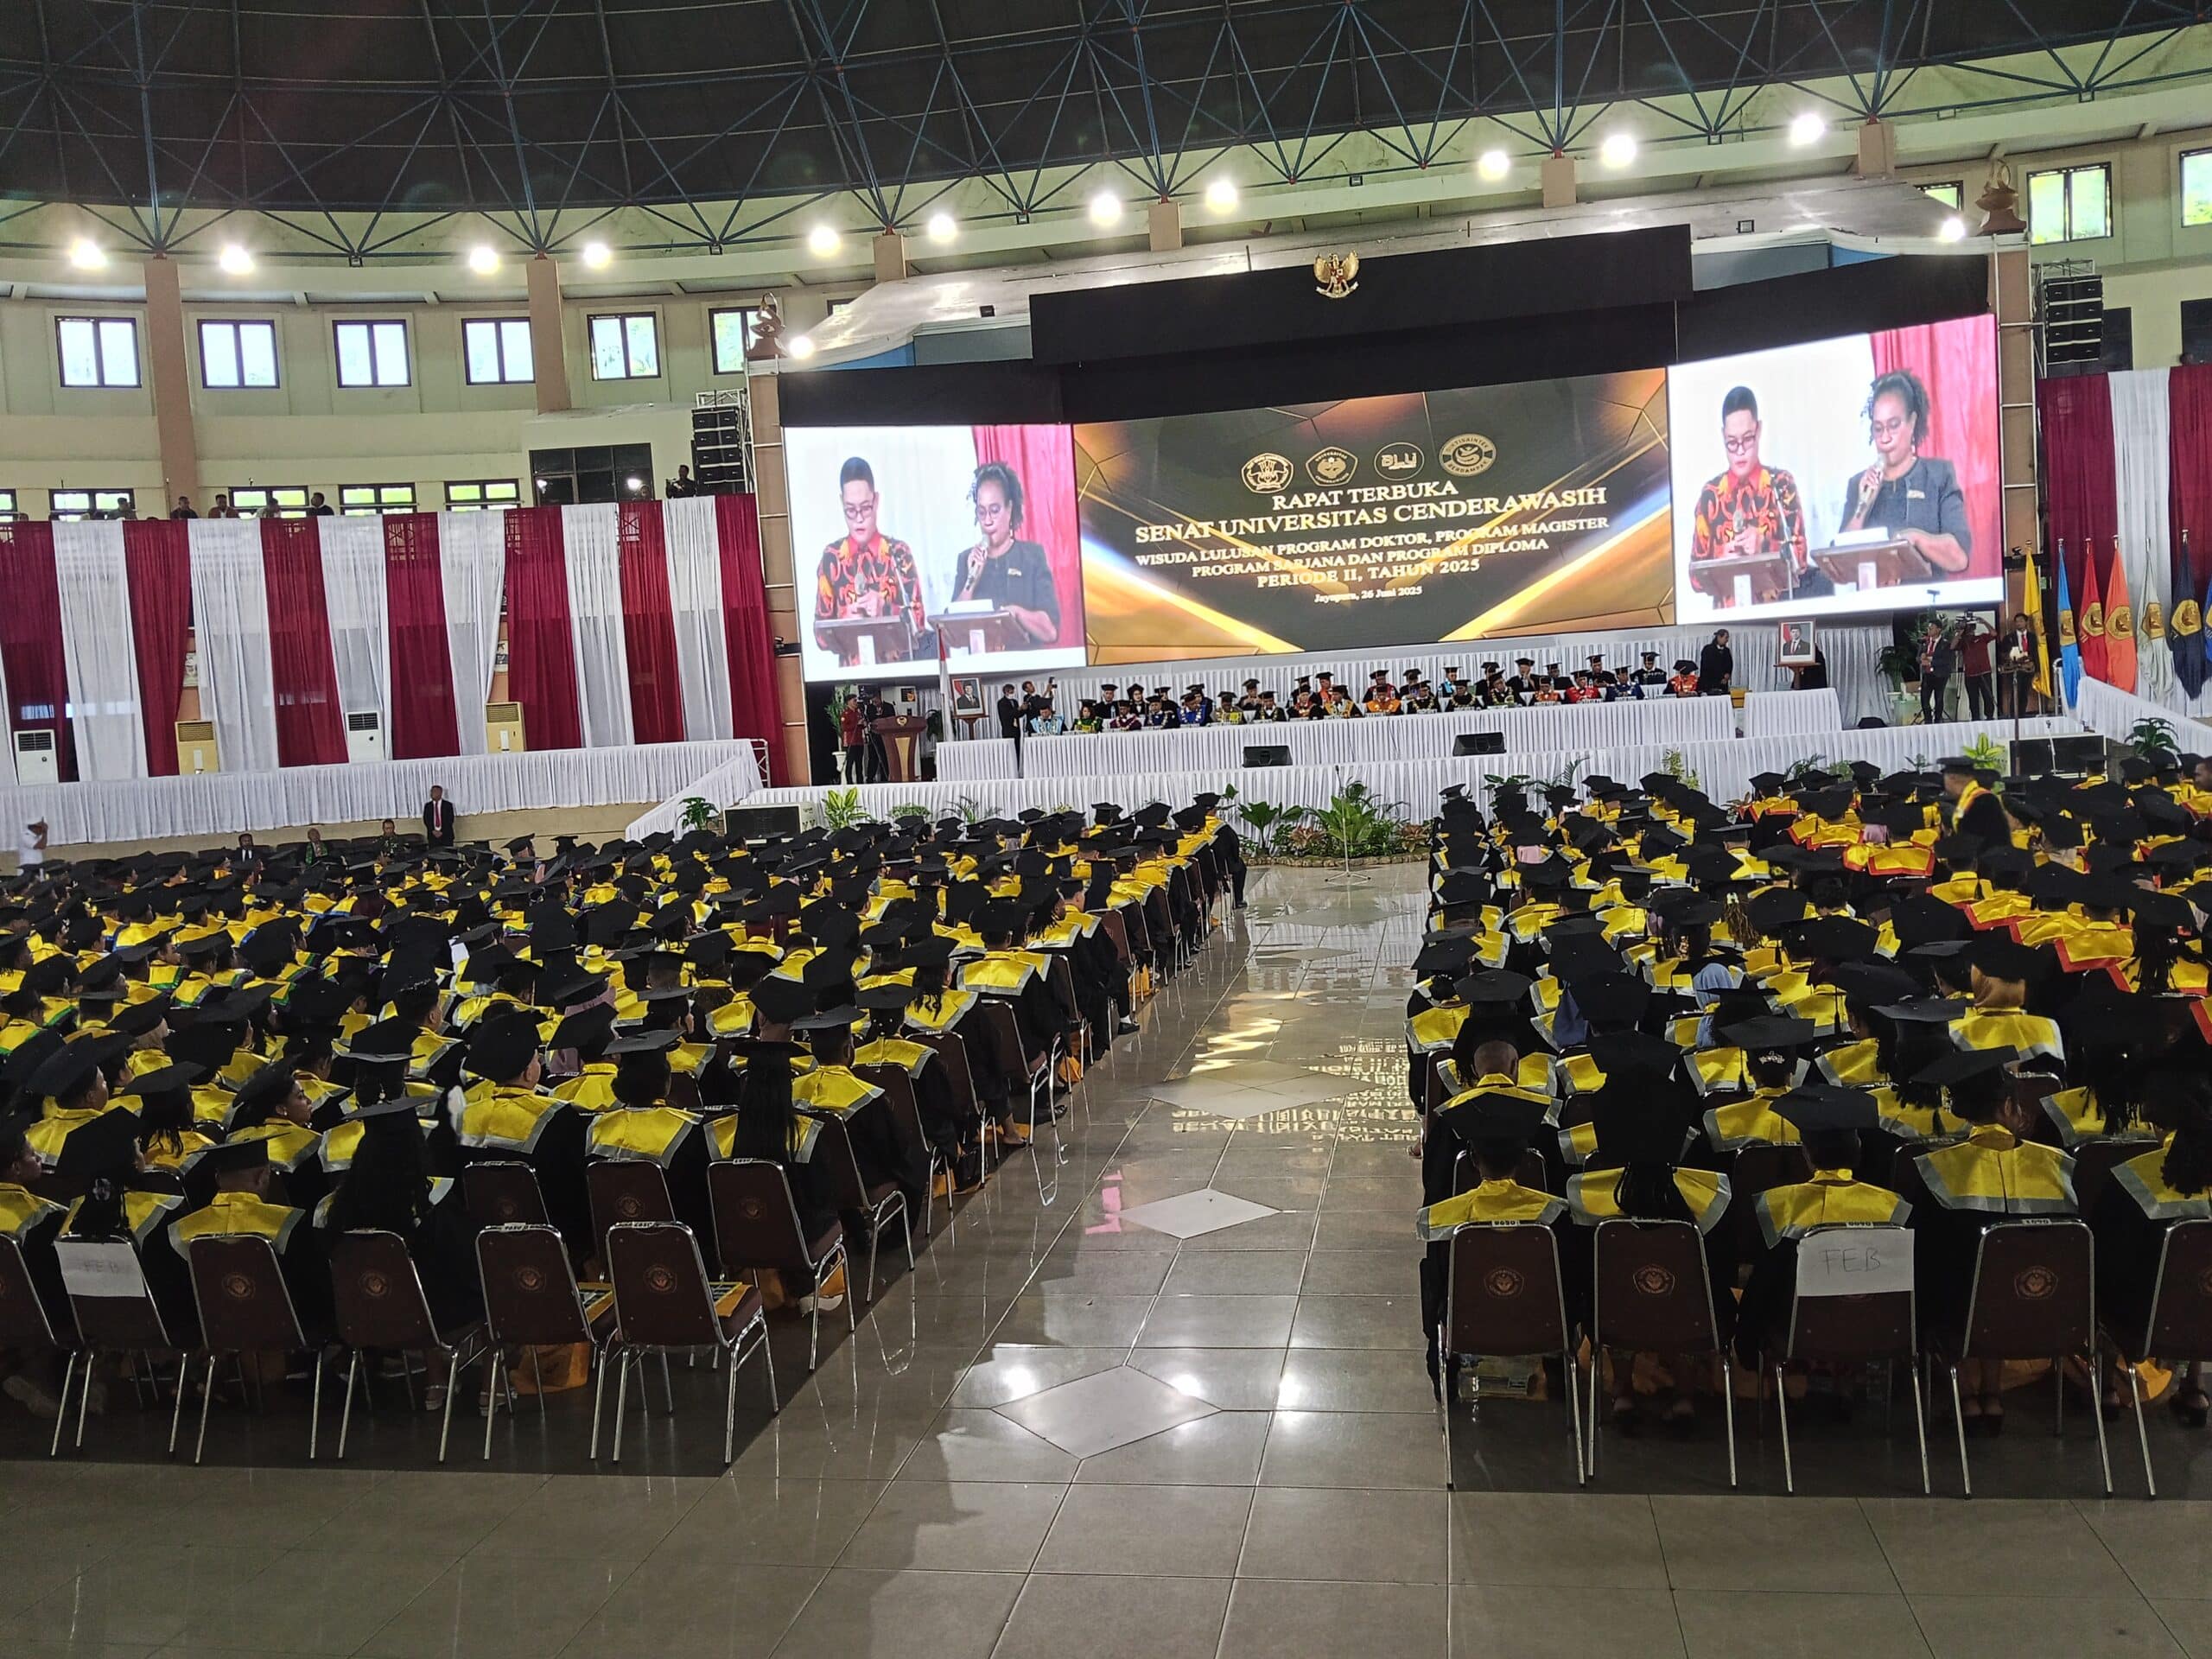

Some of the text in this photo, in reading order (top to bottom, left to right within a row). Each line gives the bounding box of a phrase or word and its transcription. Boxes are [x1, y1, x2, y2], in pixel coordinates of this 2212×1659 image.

[1272, 480, 1459, 511] RAPAT TERBUKA
[1135, 487, 1606, 543] SENAT UNIVERSITAS CENDERAWASIH
[1135, 518, 1610, 566] WISUDA LULUSAN PROGRAM DOKTOR, PROGRAM MAGISTER
[1192, 538, 1549, 578] PROGRAM SARJANA DAN PROGRAM DIPLOMA
[1257, 570, 1338, 588] PERIODE
[1367, 563, 1434, 581] TAHUN
[1440, 559, 1480, 573] 2025
[1397, 586, 1423, 595] 2025
[1819, 1247, 1880, 1275] FEB
